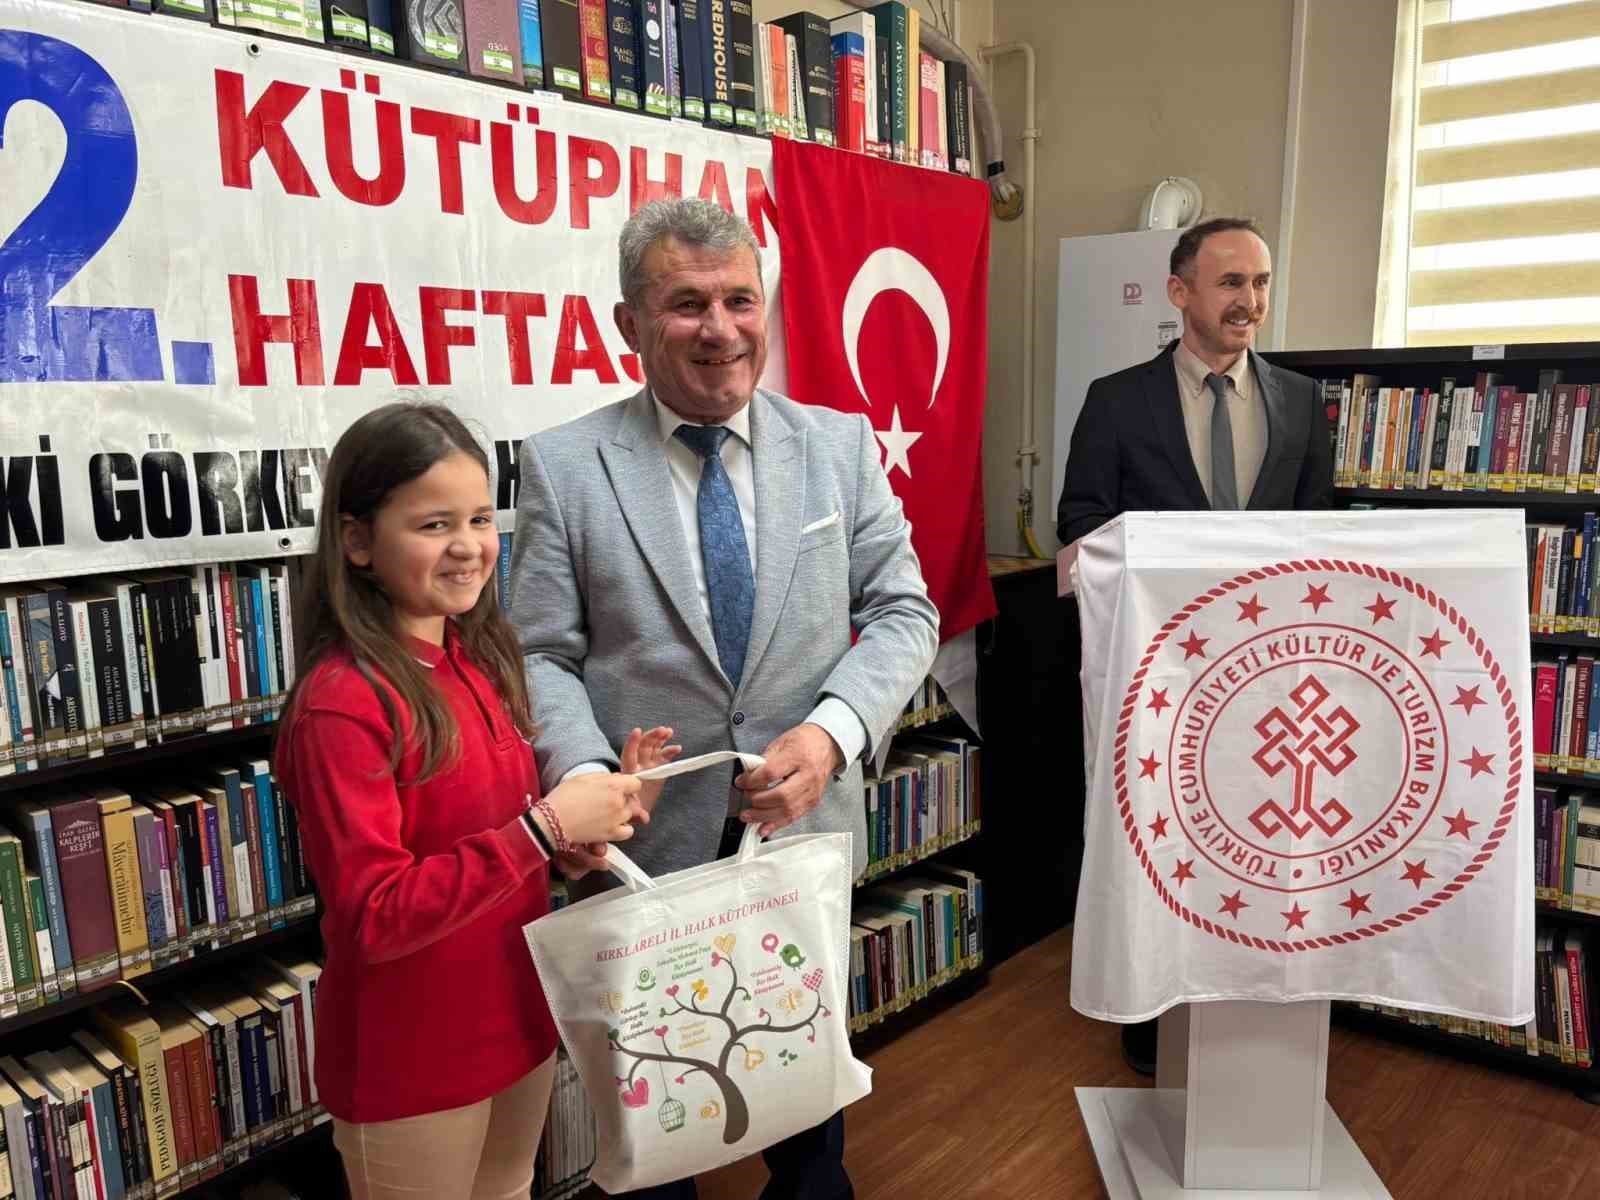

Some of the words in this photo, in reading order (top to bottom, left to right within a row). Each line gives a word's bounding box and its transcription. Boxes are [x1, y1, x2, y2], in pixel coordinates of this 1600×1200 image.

[711, 0, 728, 102] REDHOUSE
[100, 607, 110, 628] JOHN
[103, 629, 114, 653] RAWLS
[111, 666, 121, 688] AHLAK
[1267, 633, 1368, 663] KÜLTÜR
[1370, 655, 1401, 685] VE
[1179, 647, 1264, 804] CUMHURİYETİ
[1402, 681, 1436, 773] TURİZM
[59, 831, 100, 847] KALPLERİN
[1190, 805, 1278, 880] TÜRKİYE
[1319, 779, 1431, 880] BAKANLIĞI
[594, 929, 669, 963] KIRKLARELİ
[669, 926, 684, 944] İL
[683, 916, 717, 938] HALK
[718, 888, 801, 925] KÜTÜPHANESİ
[153, 1113, 171, 1172] PEDAGOJİ
